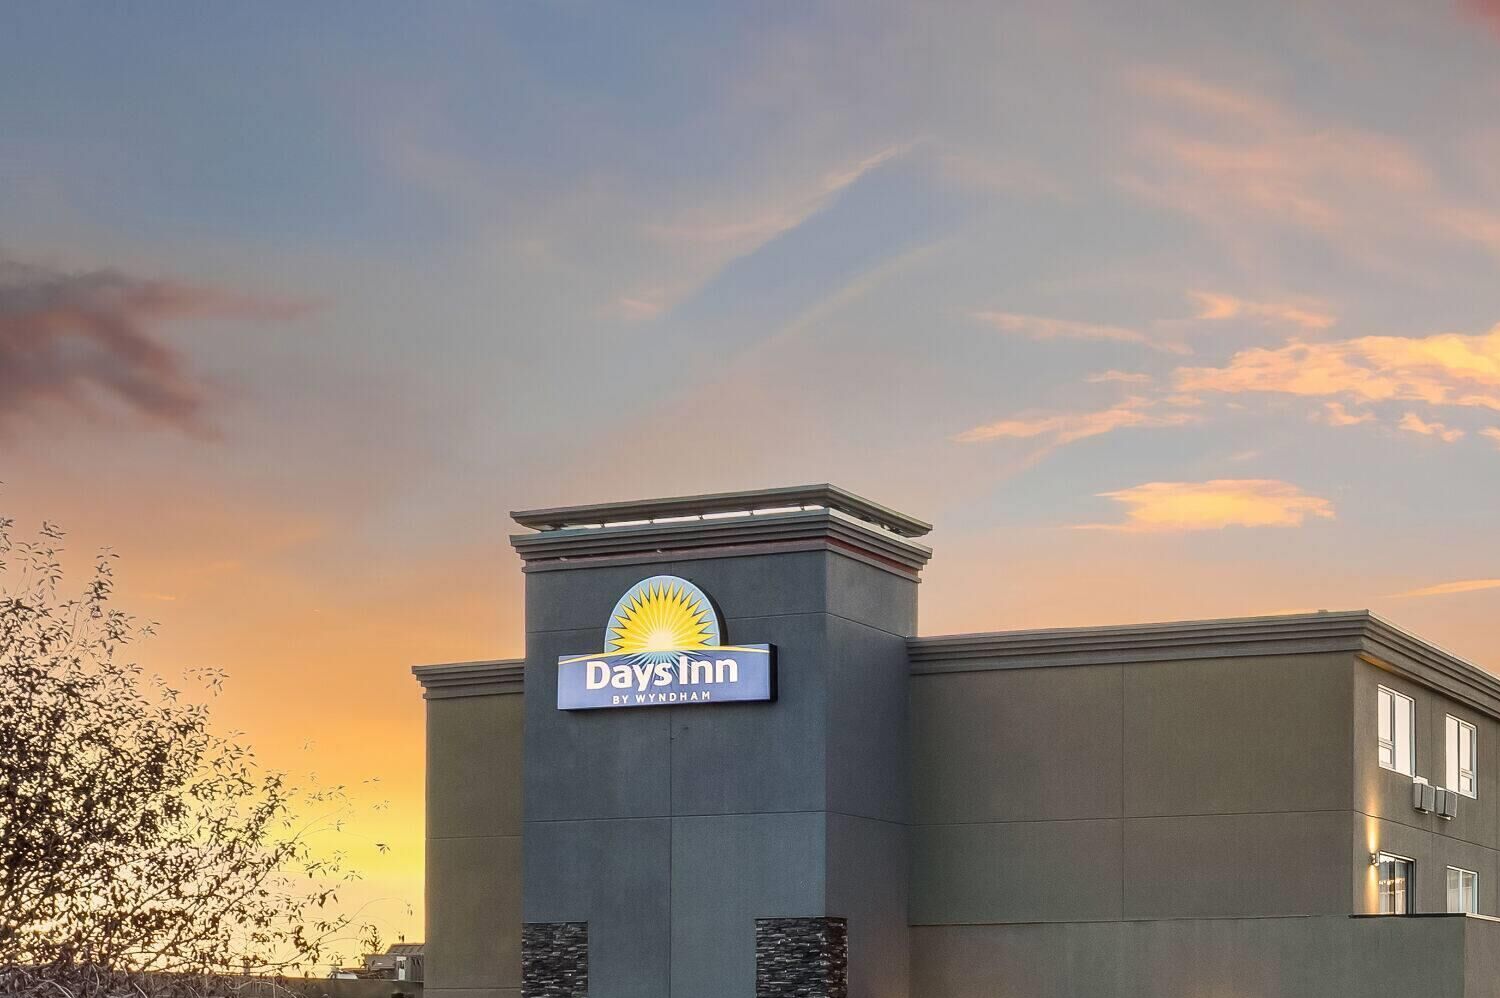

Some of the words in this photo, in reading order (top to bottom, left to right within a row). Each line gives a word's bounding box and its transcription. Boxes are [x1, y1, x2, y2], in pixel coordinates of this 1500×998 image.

[586, 661, 673, 692] Days
[679, 655, 738, 685] Inn
[612, 695, 629, 704] BY
[635, 691, 711, 703] WYNDHAM
